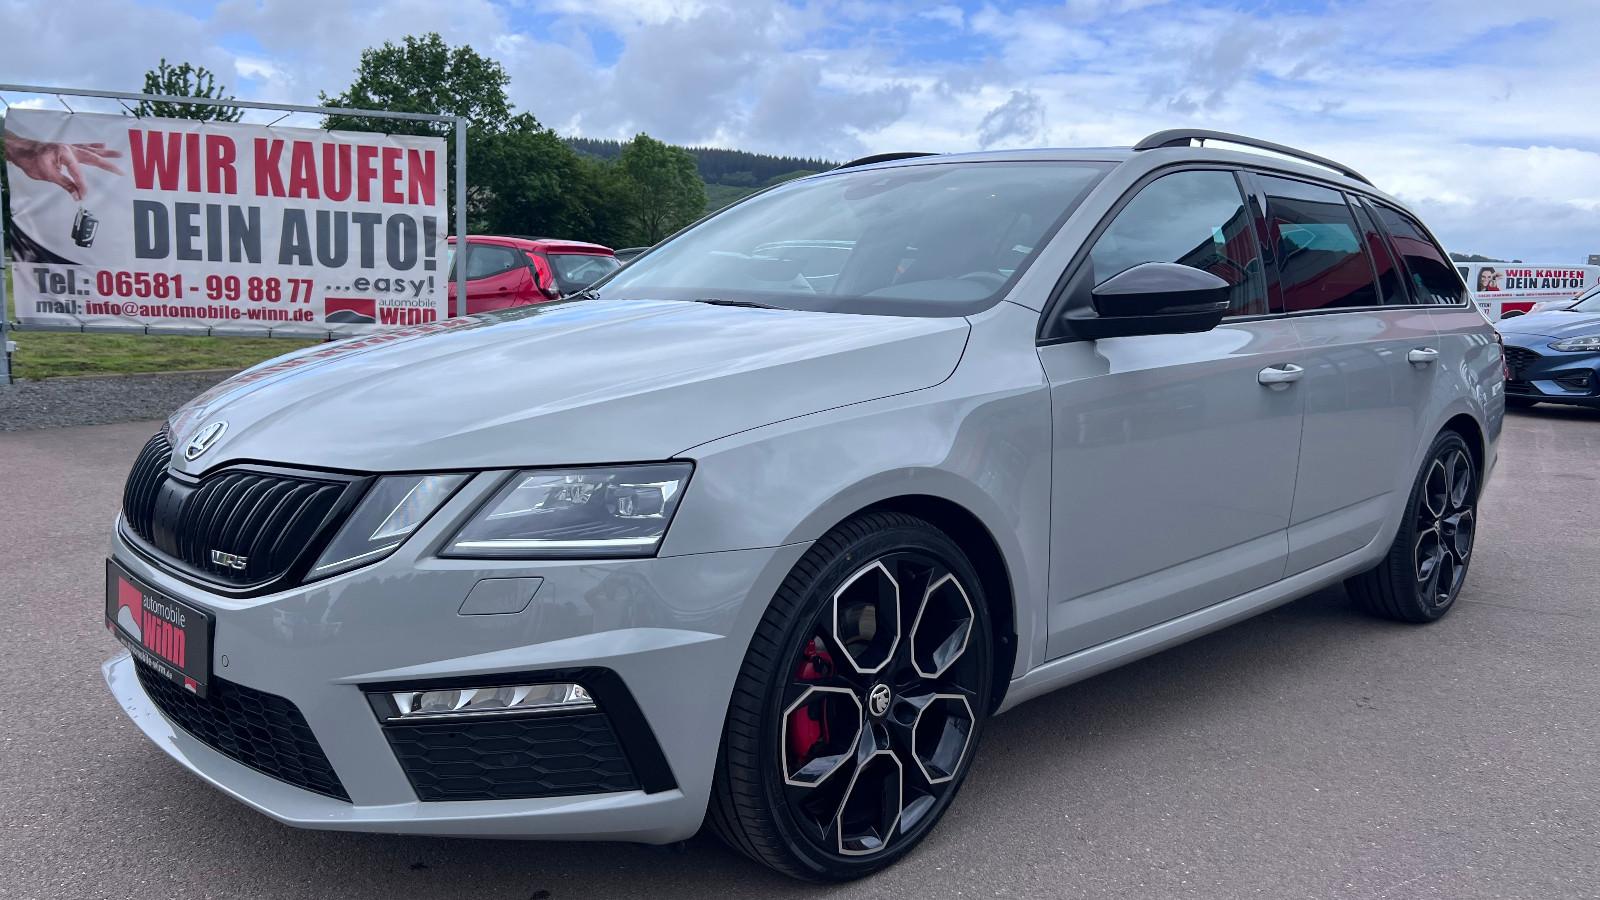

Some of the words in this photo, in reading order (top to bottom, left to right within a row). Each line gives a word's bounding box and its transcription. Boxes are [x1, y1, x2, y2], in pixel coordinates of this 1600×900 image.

[128, 129, 237, 195] WIR
[254, 138, 436, 206] KAUFEN
[133, 200, 261, 264] DEIN
[278, 208, 437, 271] AUTO!
[33, 267, 90, 295] Tel.:
[96, 270, 183, 298] 06581
[206, 275, 241, 301] 99
[247, 276, 281, 302] 88
[287, 278, 314, 303] 77
[1505, 269, 1531, 278] WIR
[1535, 270, 1584, 278] KAUFEN
[1505, 278, 1537, 289] DEIN
[1541, 278, 1584, 289] AUTO!
[36, 300, 82, 314] mail:
[86, 300, 314, 321] info@automobile-winn.de
[379, 299, 437, 307] automobile
[143, 595, 186, 627] automobile
